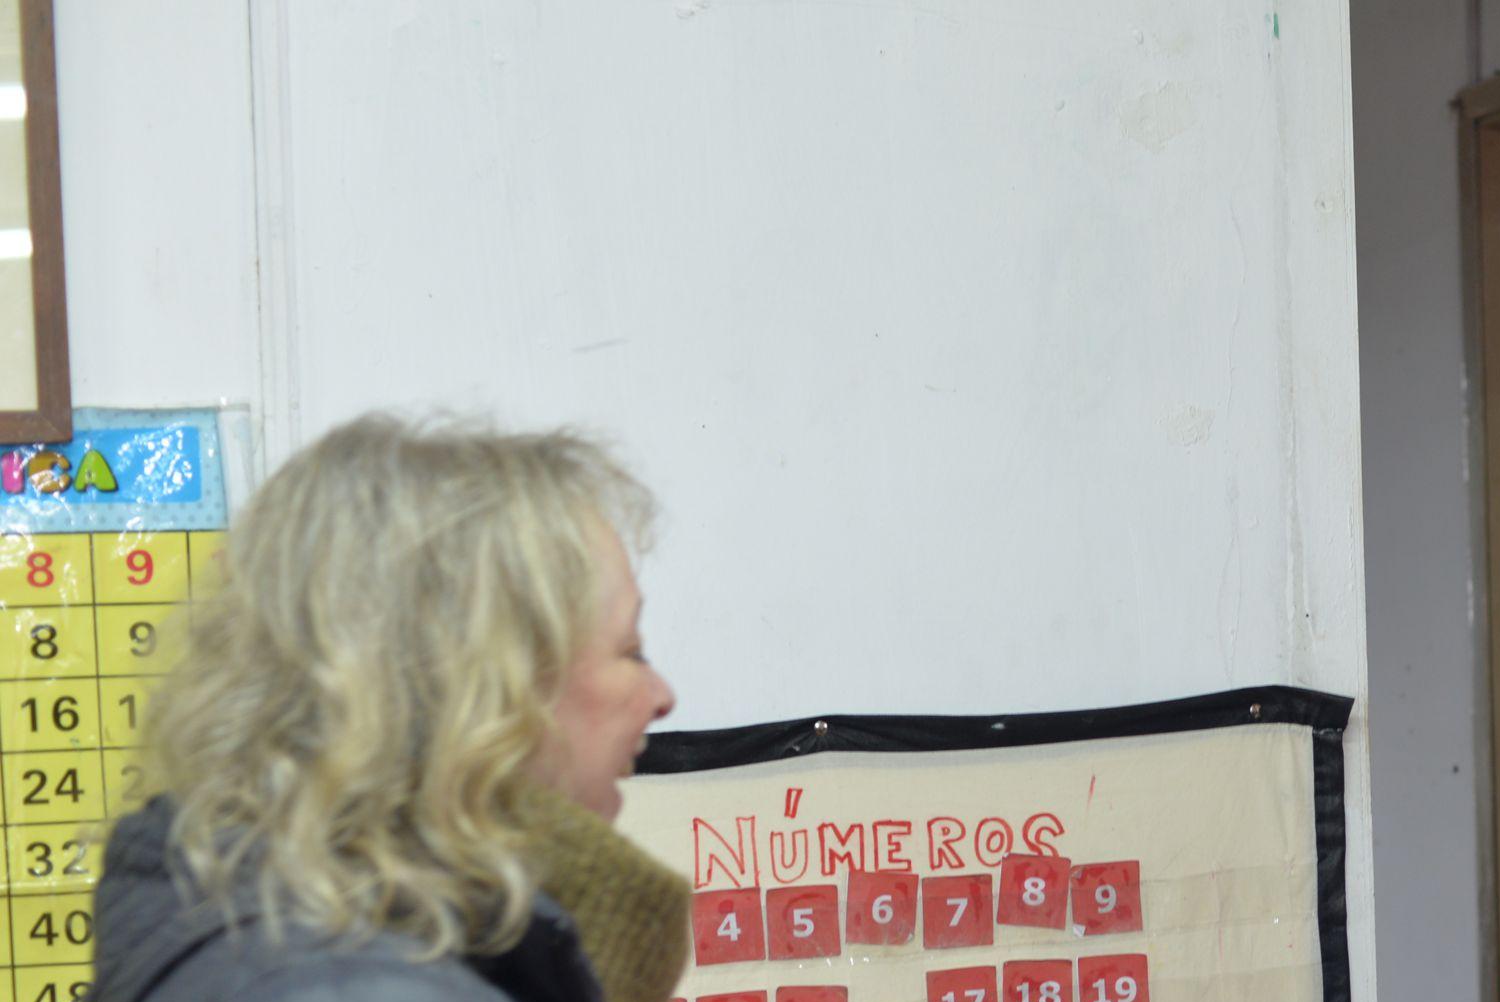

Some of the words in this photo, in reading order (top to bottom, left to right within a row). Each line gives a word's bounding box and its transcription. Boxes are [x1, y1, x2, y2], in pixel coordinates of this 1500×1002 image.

[26, 552, 55, 587] 8
[126, 549, 154, 586] 9
[30, 625, 59, 660] 8
[129, 622, 157, 657] 9
[20, 696, 80, 732] 16
[22, 768, 85, 805] 24
[692, 787, 1066, 890] NÚMEROS
[25, 840, 90, 877] 32
[717, 913, 741, 941] 4
[794, 908, 814, 937] 5
[872, 895, 893, 924] 6
[947, 898, 967, 926] 7
[1023, 877, 1045, 906] 8
[1095, 885, 1116, 913] 9
[29, 911, 94, 947] 40
